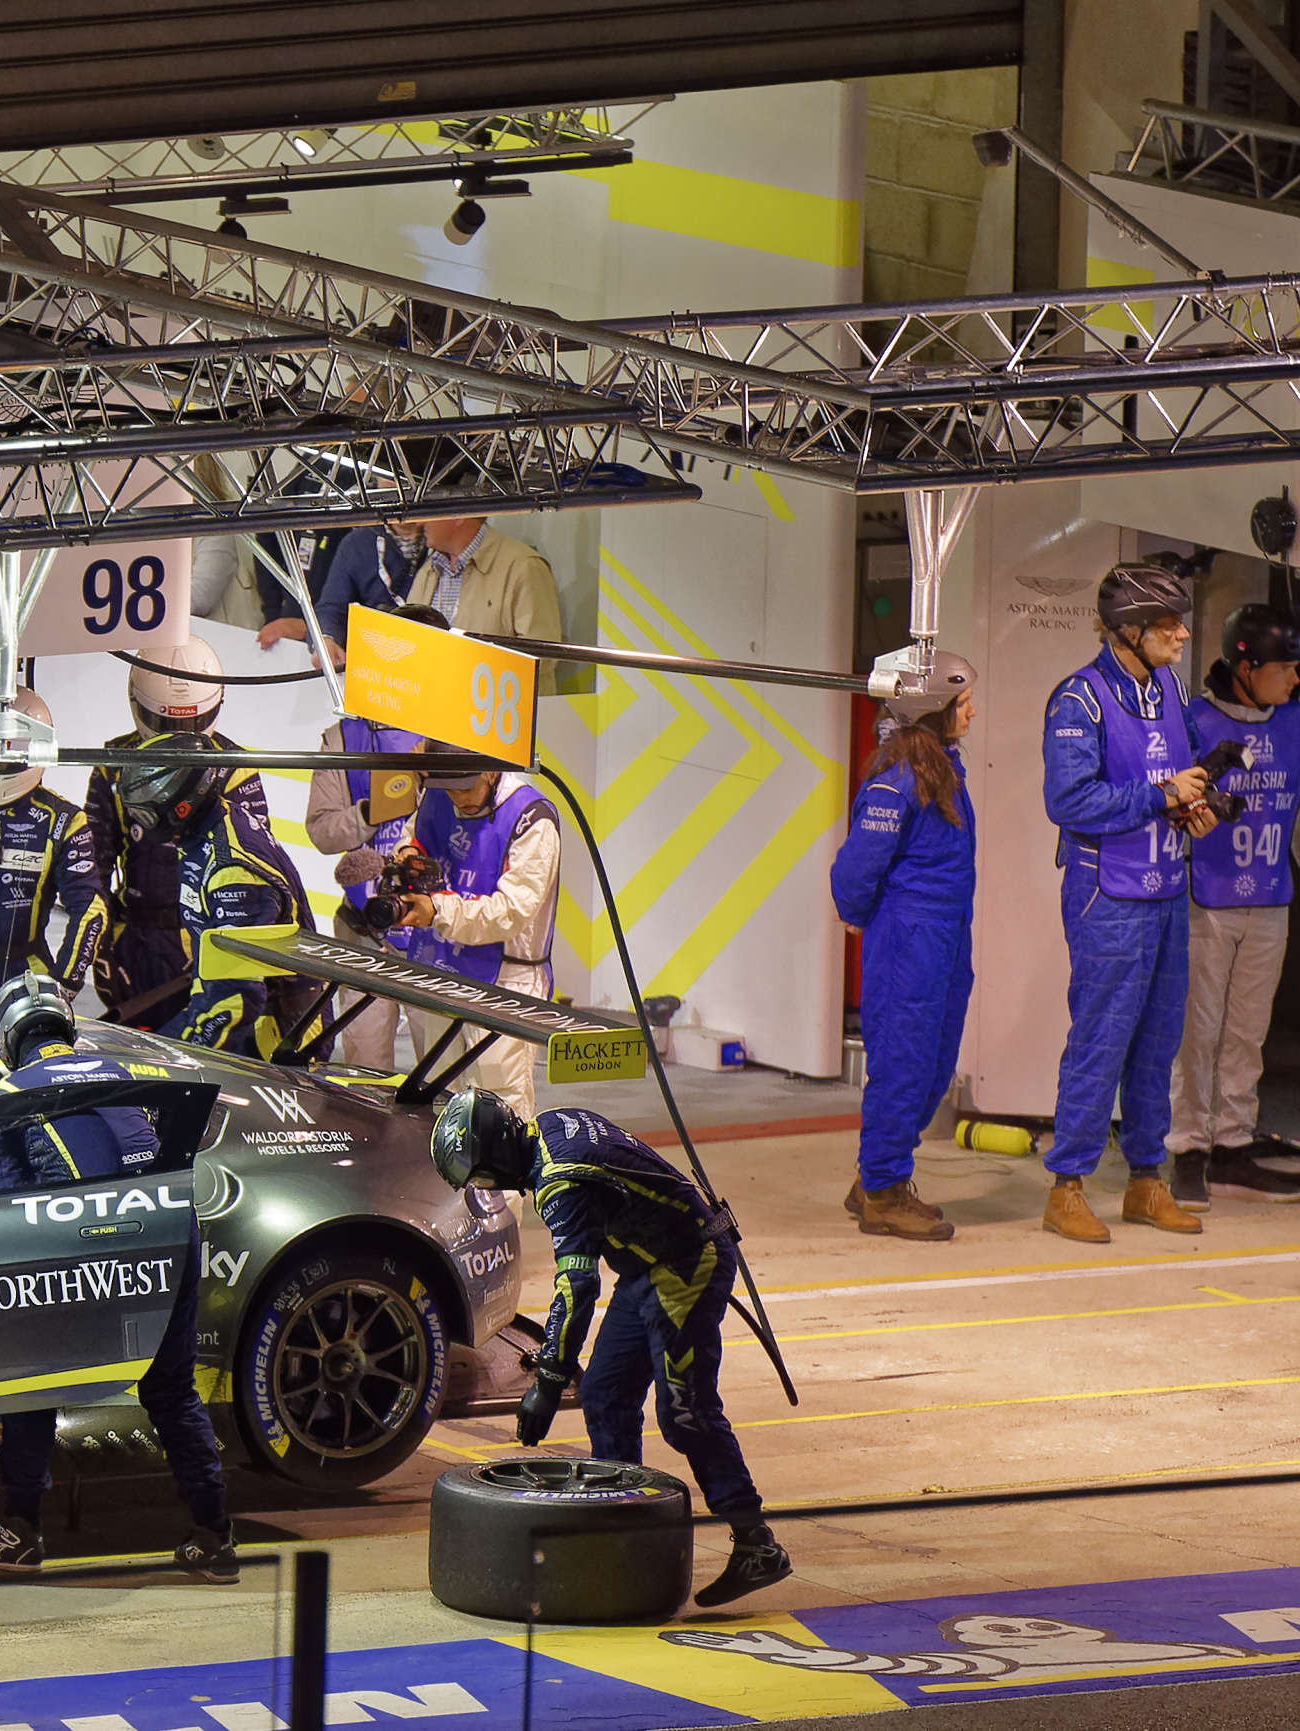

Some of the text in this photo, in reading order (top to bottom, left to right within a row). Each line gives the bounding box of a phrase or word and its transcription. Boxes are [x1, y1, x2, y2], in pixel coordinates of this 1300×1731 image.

[82, 555, 166, 635] 98
[1006, 603, 1100, 617] ASTON MARTIN
[1029, 618, 1076, 631] RACING
[385, 675, 421, 697] MARTIN
[168, 706, 197, 716] TOTAL
[470, 662, 521, 745] 98
[28, 807, 49, 822] sky
[1232, 822, 1282, 867] 940
[553, 1038, 645, 1065] HACKETT
[575, 1060, 621, 1073] LONDON
[257, 1145, 296, 1156] HOTELS
[11, 1185, 190, 1225] TOTAL
[200, 1240, 250, 1288] ky
[459, 1241, 515, 1279] TOTAL
[254, 1317, 279, 1422] MICHELIN
[423, 1312, 445, 1416] MICHELIN
